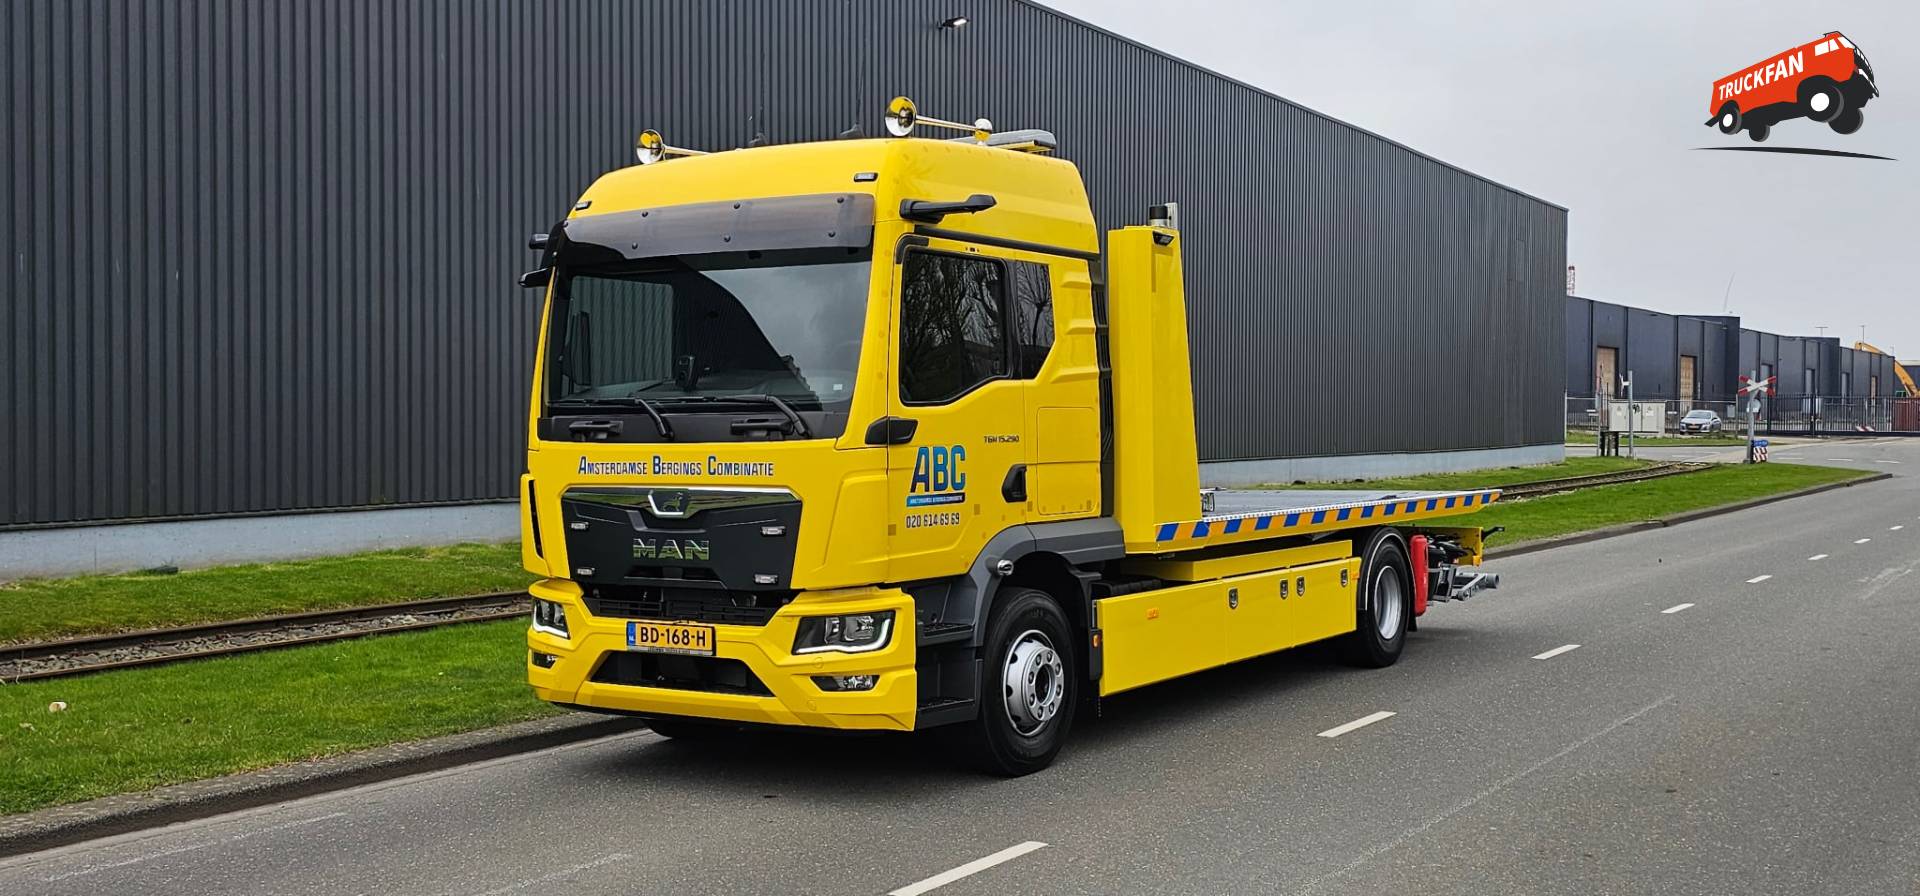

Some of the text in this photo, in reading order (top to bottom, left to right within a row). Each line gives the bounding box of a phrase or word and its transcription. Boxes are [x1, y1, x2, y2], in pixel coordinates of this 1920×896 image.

[578, 456, 774, 477] AMSTERDAMSE BERGINGS COMBINATIE
[910, 445, 966, 493] ABC
[906, 515, 921, 528] 020
[632, 538, 710, 560] MAN
[640, 626, 706, 647] BD-168-H
